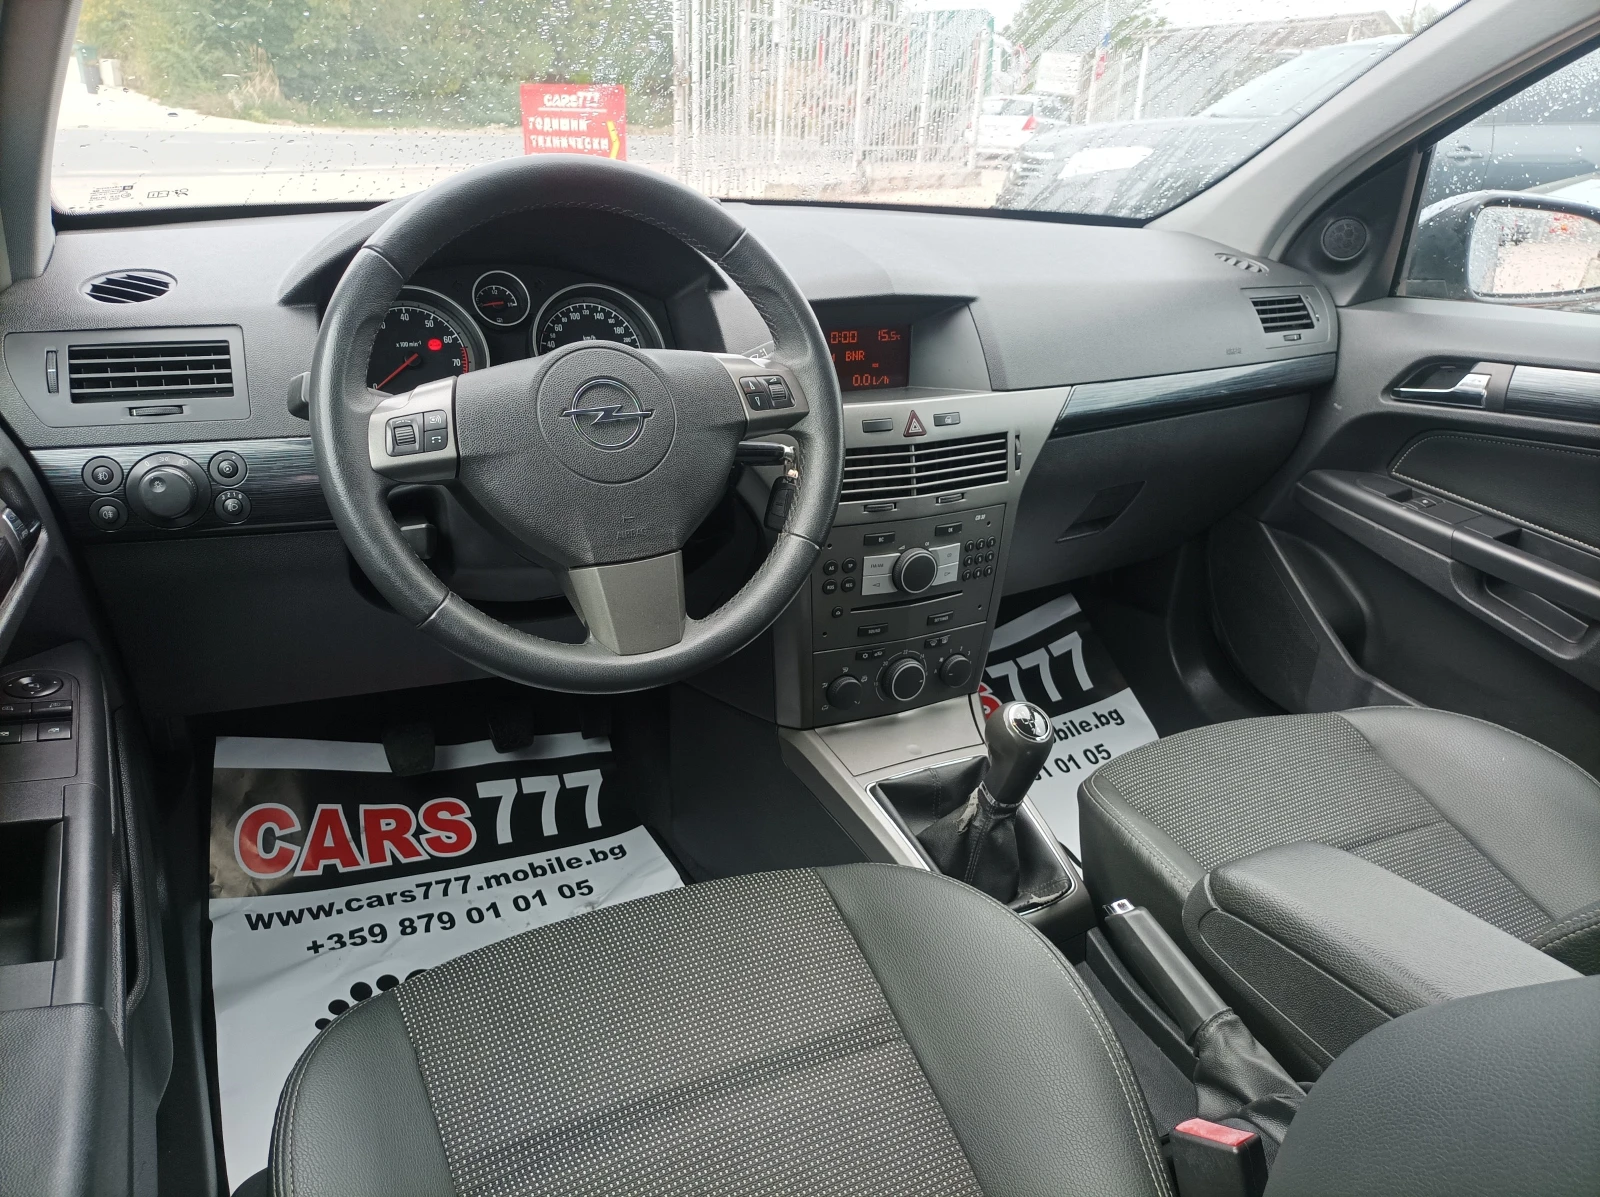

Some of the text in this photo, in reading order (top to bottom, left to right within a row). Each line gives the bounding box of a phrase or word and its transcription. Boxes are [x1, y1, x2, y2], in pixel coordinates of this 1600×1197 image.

[400, 313, 410, 321] 40
[569, 312, 581, 320] 100
[593, 312, 605, 320] 140
[425, 320, 434, 328] 50
[554, 324, 563, 332] 60
[613, 326, 625, 335] 180
[443, 335, 453, 344] 60
[546, 340, 556, 348] 40
[845, 350, 865, 361] BNR
[452, 358, 461, 367] 70
[1054, 753, 1082, 773] 01
[1083, 743, 1112, 765] 05
[245, 842, 628, 931] www.cars777.mobile.bg
[306, 879, 595, 955] +359 879 01 01 05
